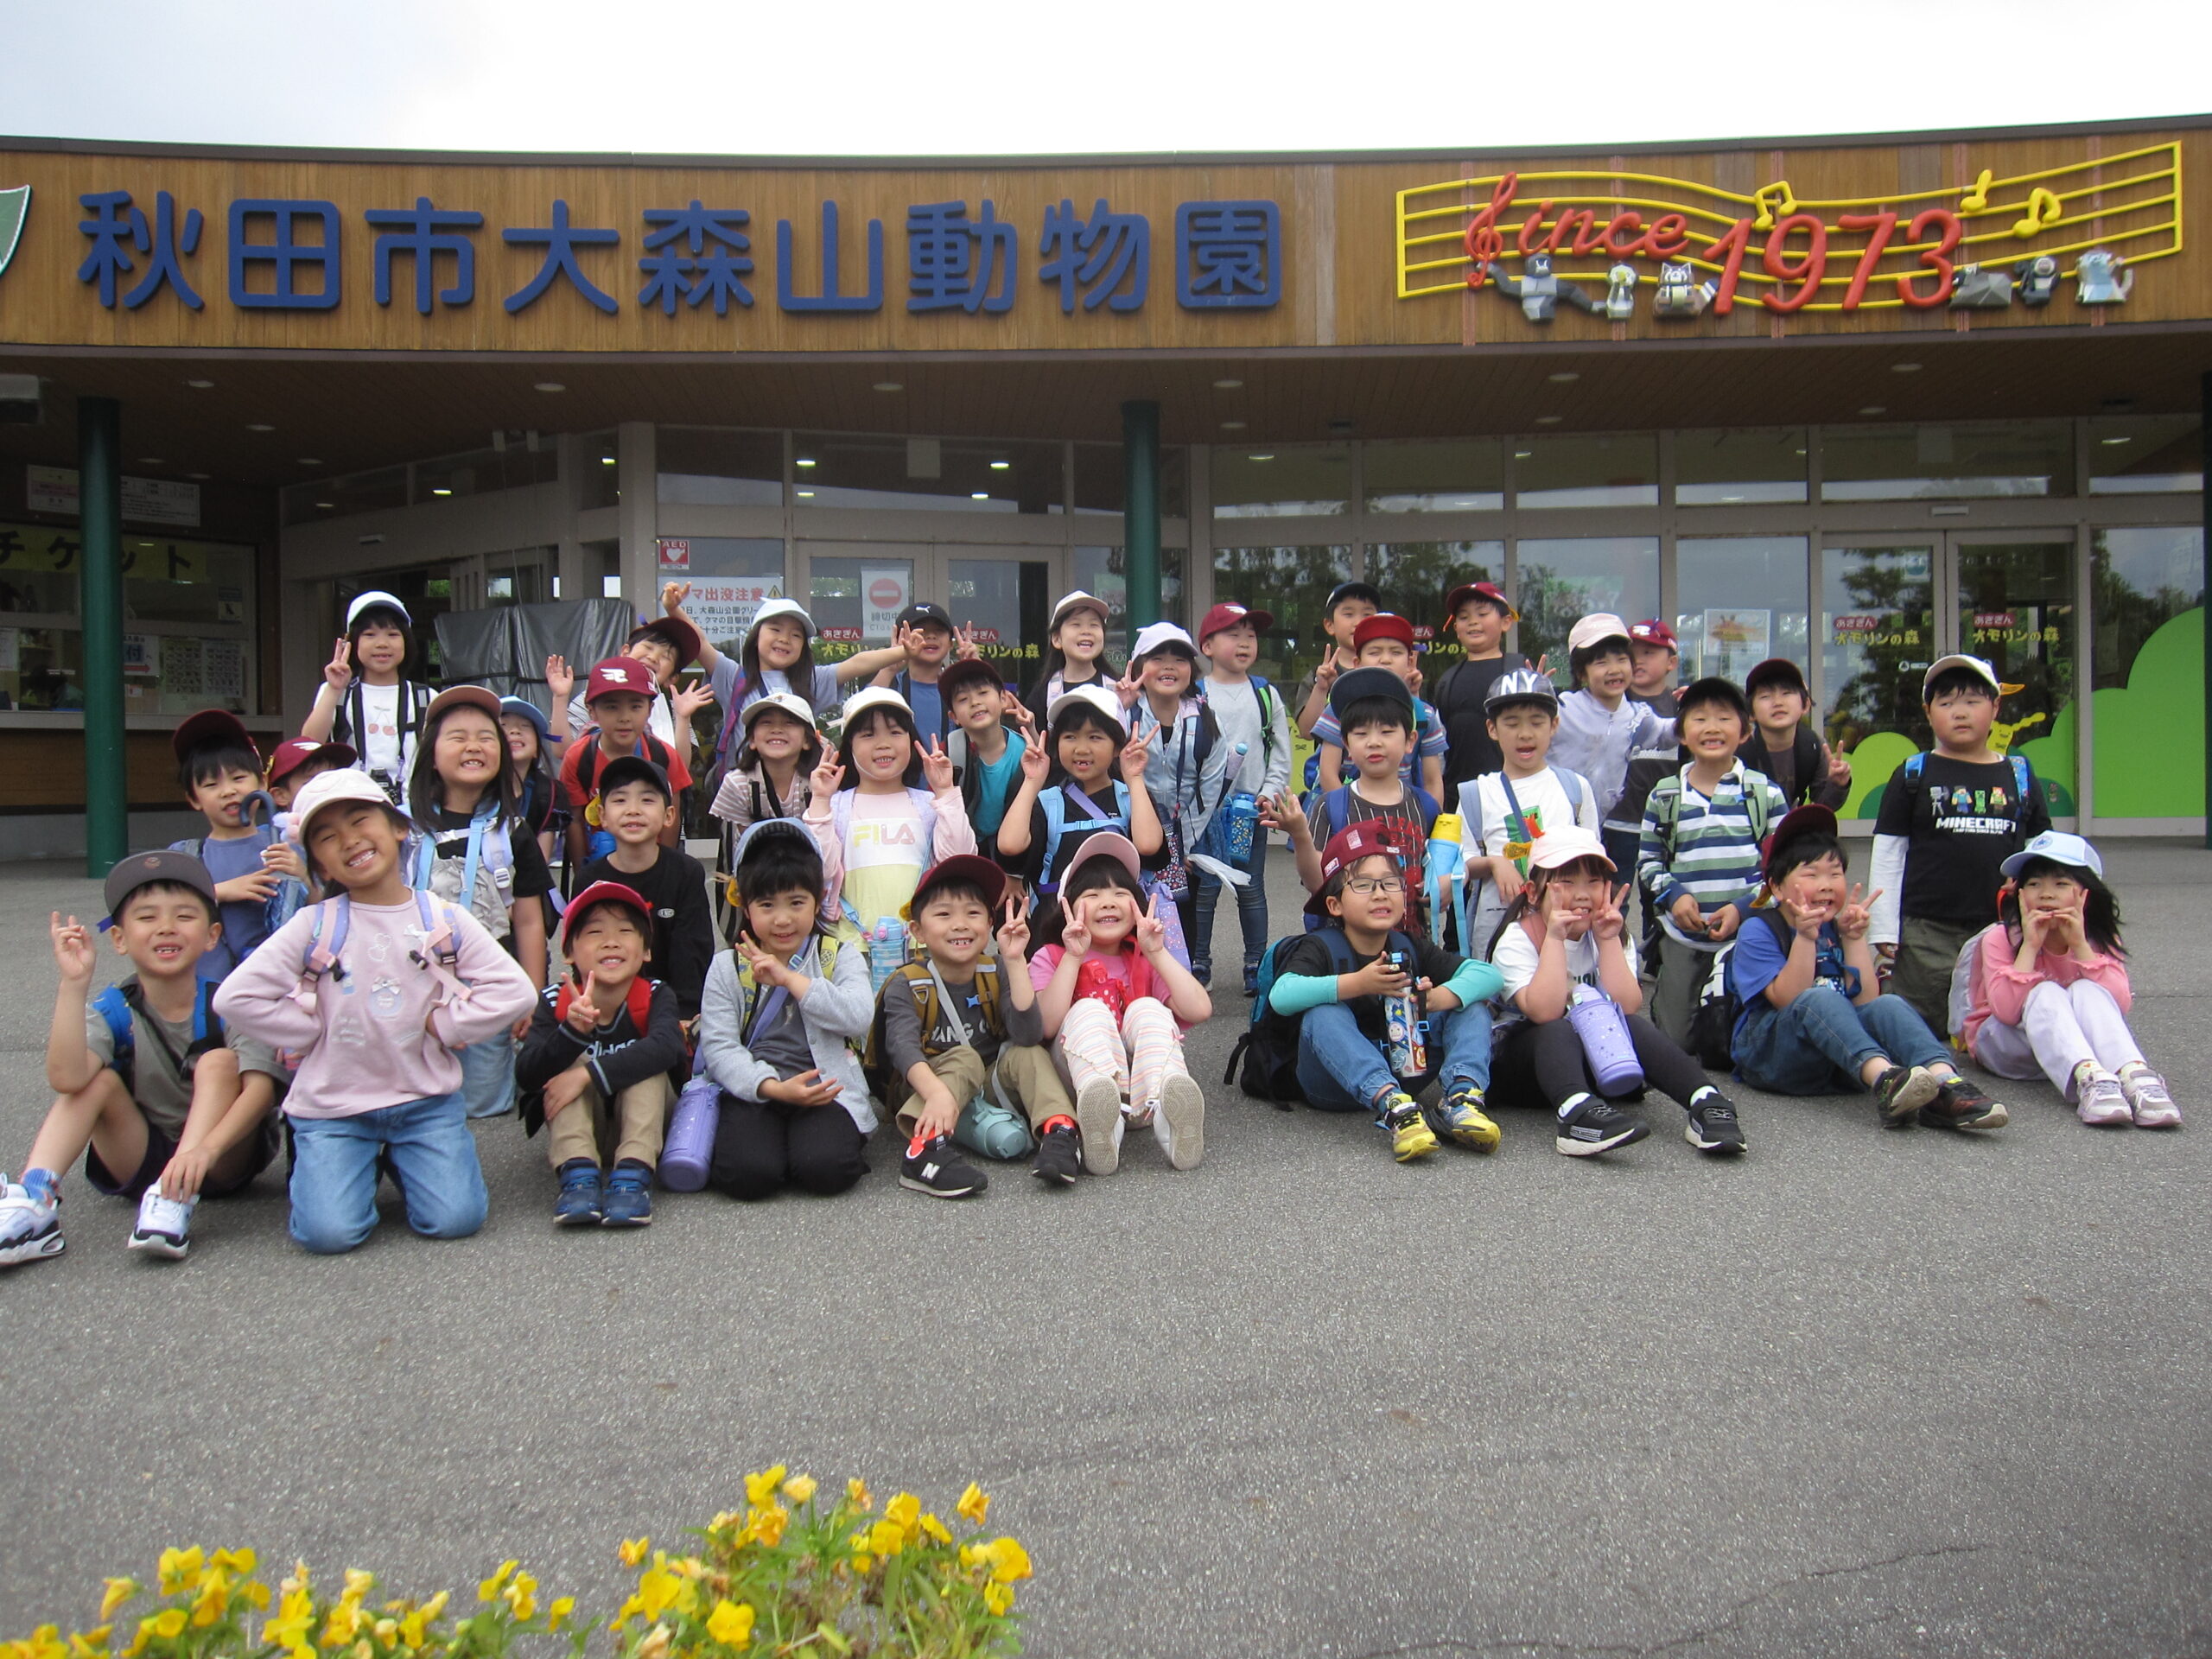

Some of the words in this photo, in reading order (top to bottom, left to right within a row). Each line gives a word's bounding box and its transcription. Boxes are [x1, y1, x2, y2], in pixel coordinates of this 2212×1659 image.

[78, 189, 1281, 315] 秋田市大森山動物園
[1702, 208, 1963, 315] 1973
[678, 587, 764, 602] マ出没注意
[1836, 619, 1873, 628] あきぎん
[1974, 615, 2012, 626] あきぎん
[823, 629, 860, 639] あきぎん
[1501, 671, 1538, 696] NY
[1936, 817, 2016, 833] MINECRAFT
[853, 823, 916, 848] FILA
